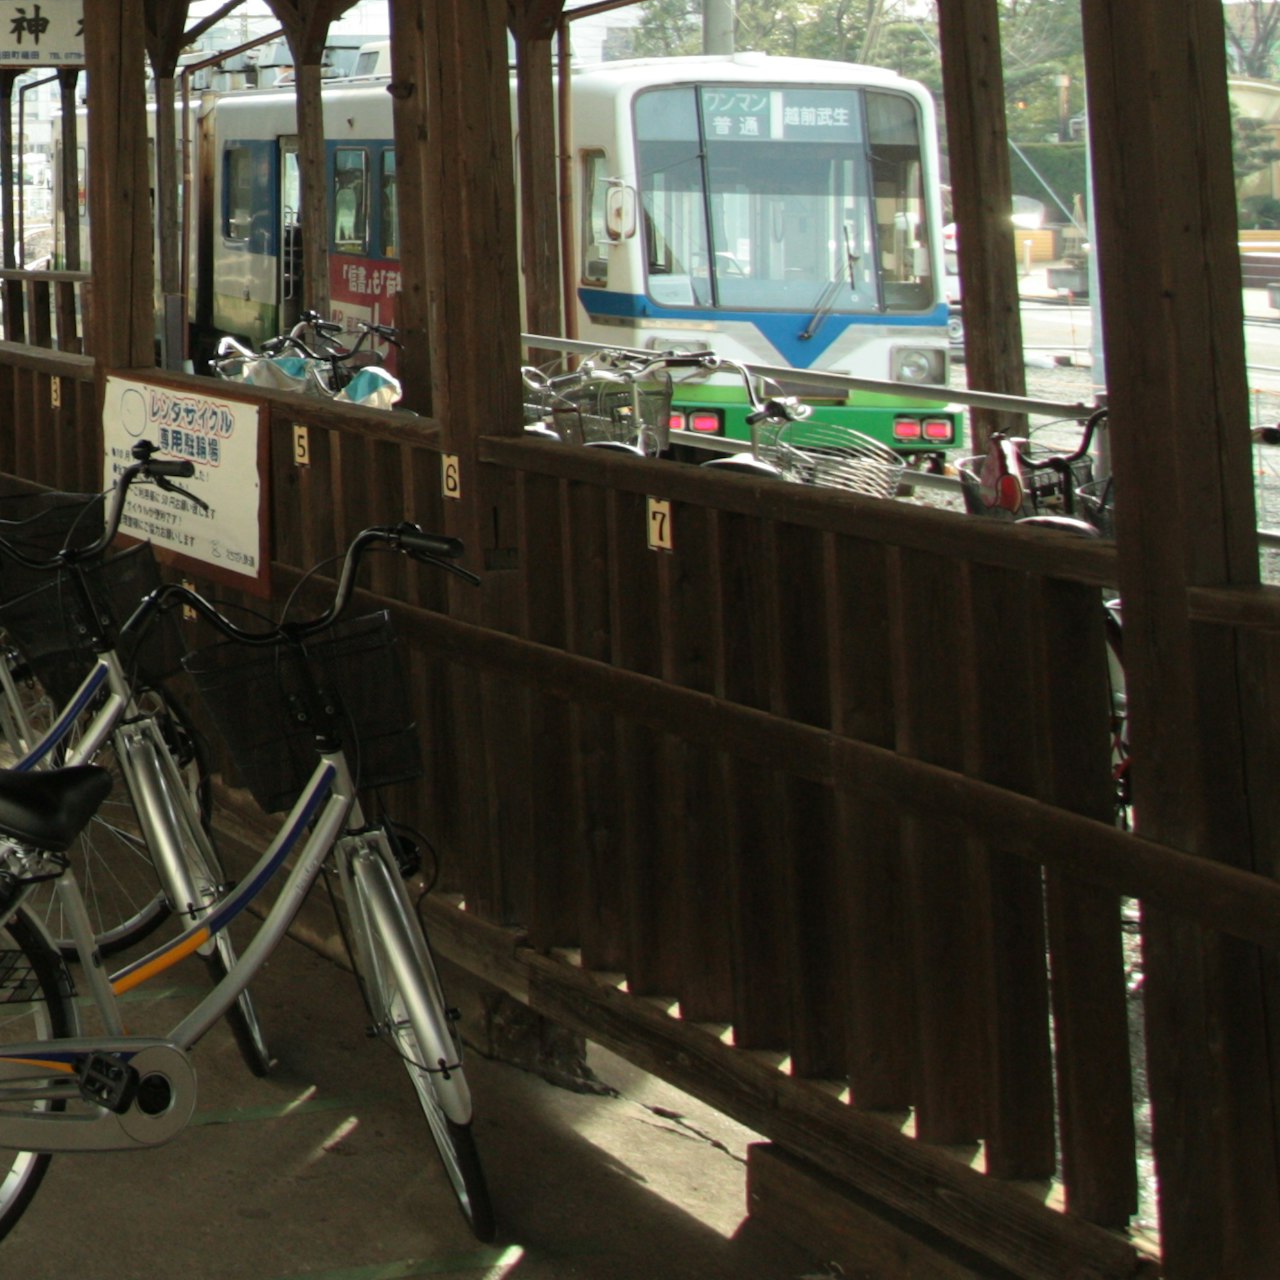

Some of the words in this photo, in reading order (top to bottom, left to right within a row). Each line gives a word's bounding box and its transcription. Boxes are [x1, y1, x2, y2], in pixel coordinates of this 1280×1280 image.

[703, 93, 767, 111] ワンマン
[712, 116, 759, 136] 普通
[783, 106, 850, 127] 越前武生
[151, 394, 233, 434] レンタサイクル
[159, 427, 219, 463] 専用駐輪場
[296, 434, 306, 458] 5
[445, 463, 458, 492] 6
[651, 510, 666, 542] 7
